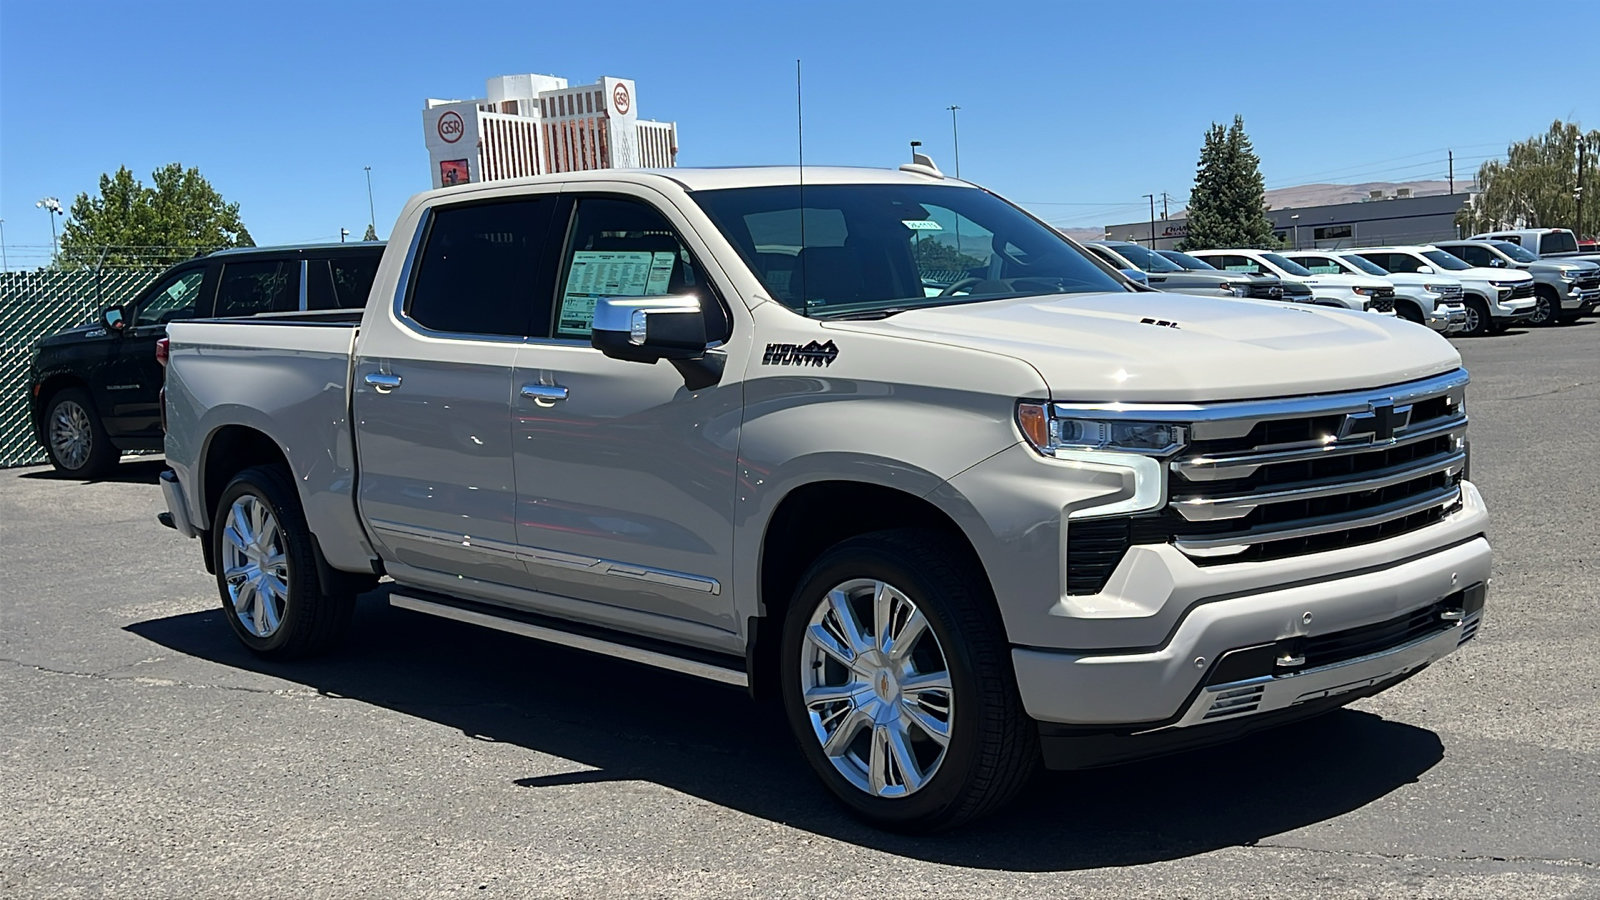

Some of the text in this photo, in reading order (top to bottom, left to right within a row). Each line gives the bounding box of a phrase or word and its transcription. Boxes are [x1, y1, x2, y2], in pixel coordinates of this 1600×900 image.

[616, 92, 628, 105] GSR
[441, 120, 460, 134] GSR
[765, 343, 803, 355] HIGH
[762, 352, 837, 368] COUNTRY
